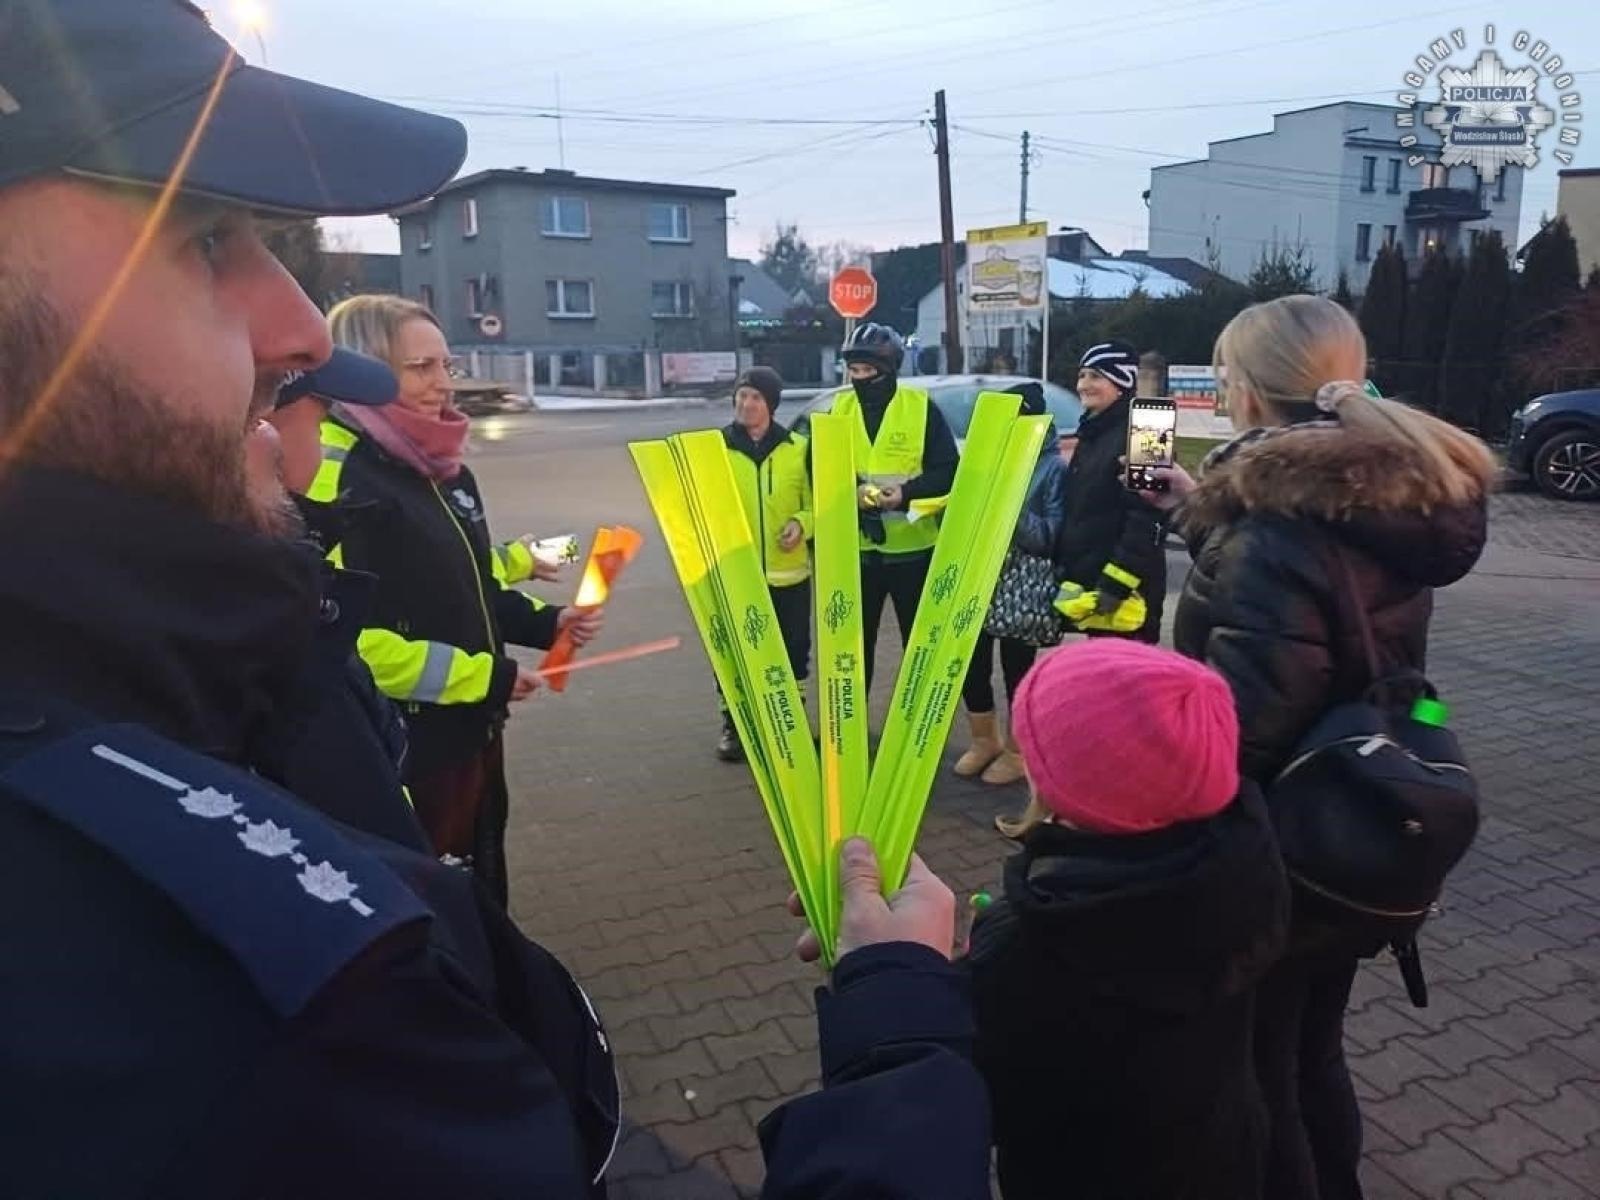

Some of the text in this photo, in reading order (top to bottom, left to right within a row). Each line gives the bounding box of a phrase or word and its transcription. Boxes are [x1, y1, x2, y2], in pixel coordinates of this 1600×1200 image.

[835, 283, 872, 299] STOP
[776, 690, 795, 732] POLICJA
[843, 678, 853, 720] POLICJA
[935, 683, 953, 724] POLICJA
